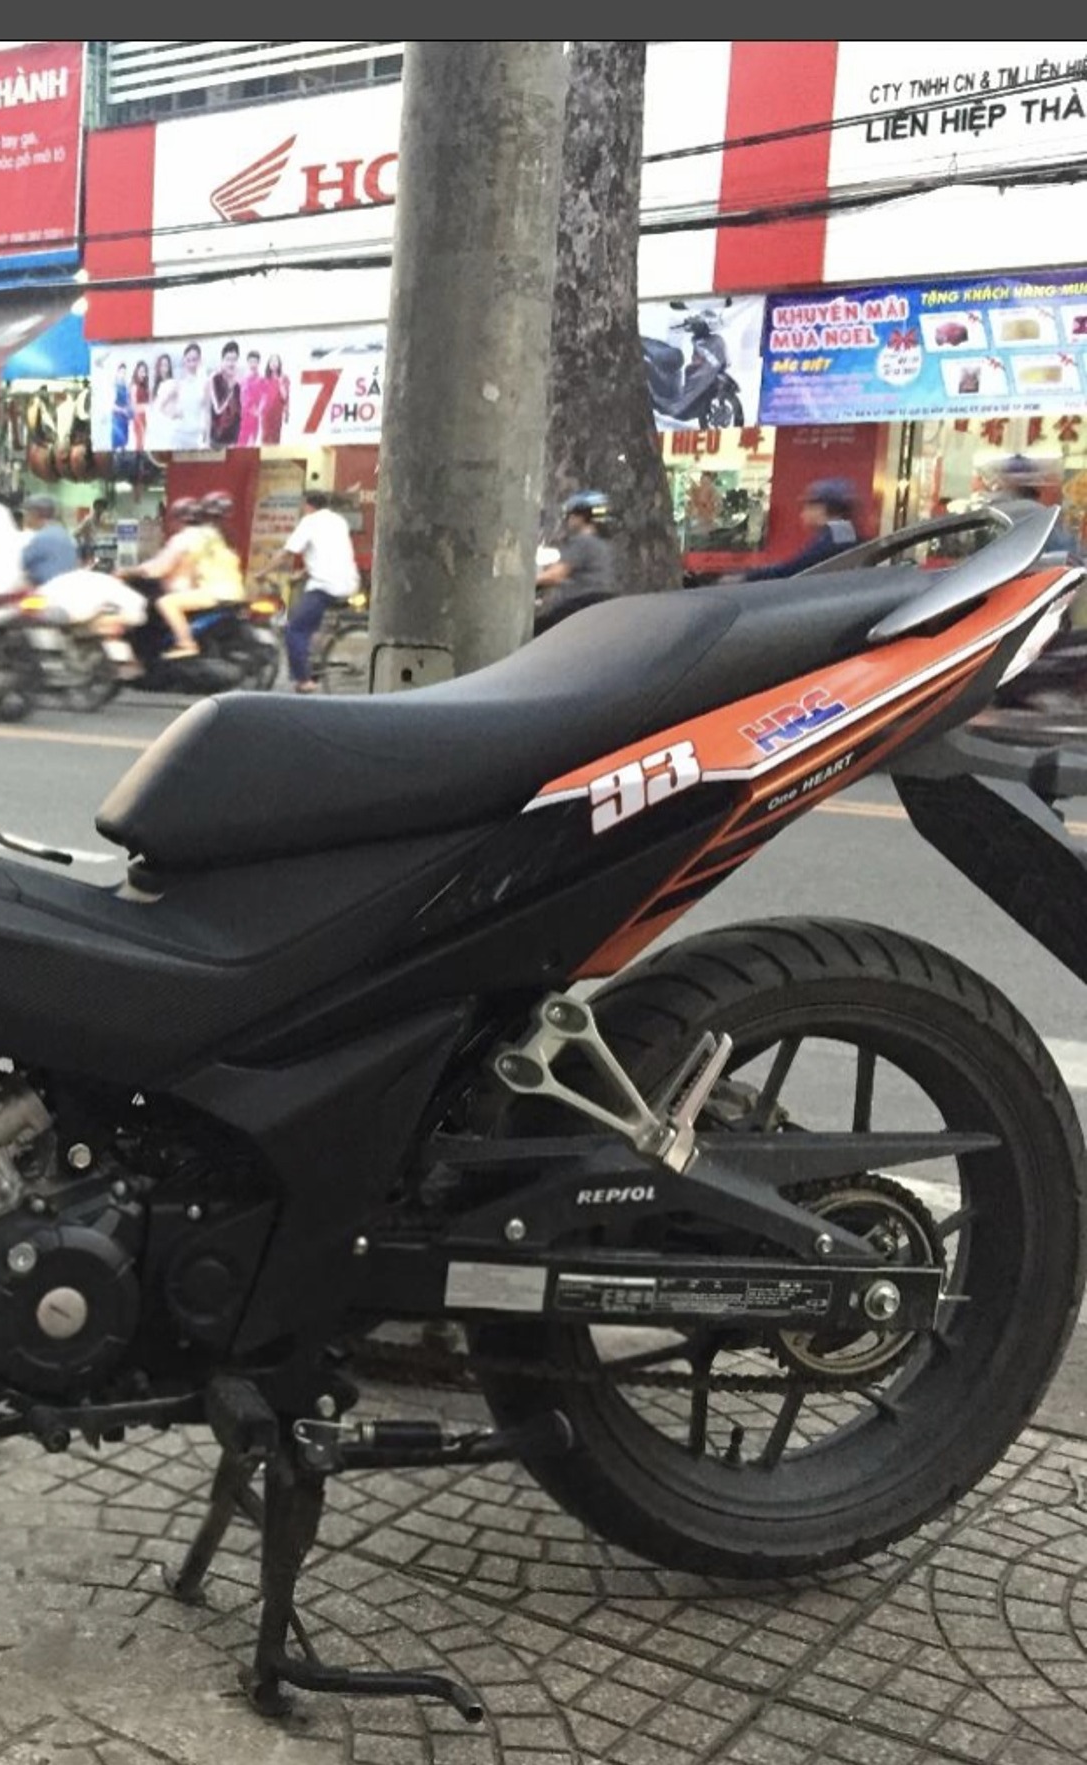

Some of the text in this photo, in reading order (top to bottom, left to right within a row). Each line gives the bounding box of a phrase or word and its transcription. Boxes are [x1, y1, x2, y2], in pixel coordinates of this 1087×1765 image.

[870, 82, 903, 104] CTY
[909, 76, 949, 99] TNHH
[954, 72, 976, 93] CN
[980, 70, 992, 89] &
[998, 65, 1020, 89] TM
[940, 100, 1007, 138] HIỆP
[1020, 87, 1086, 124] THÀ
[821, 324, 878, 349] NOEL
[300, 368, 344, 435] 7
[738, 687, 852, 754] HRC
[587, 739, 703, 836] 93
[767, 752, 856, 812] One HEART
[576, 1183, 656, 1206] REPSOL
